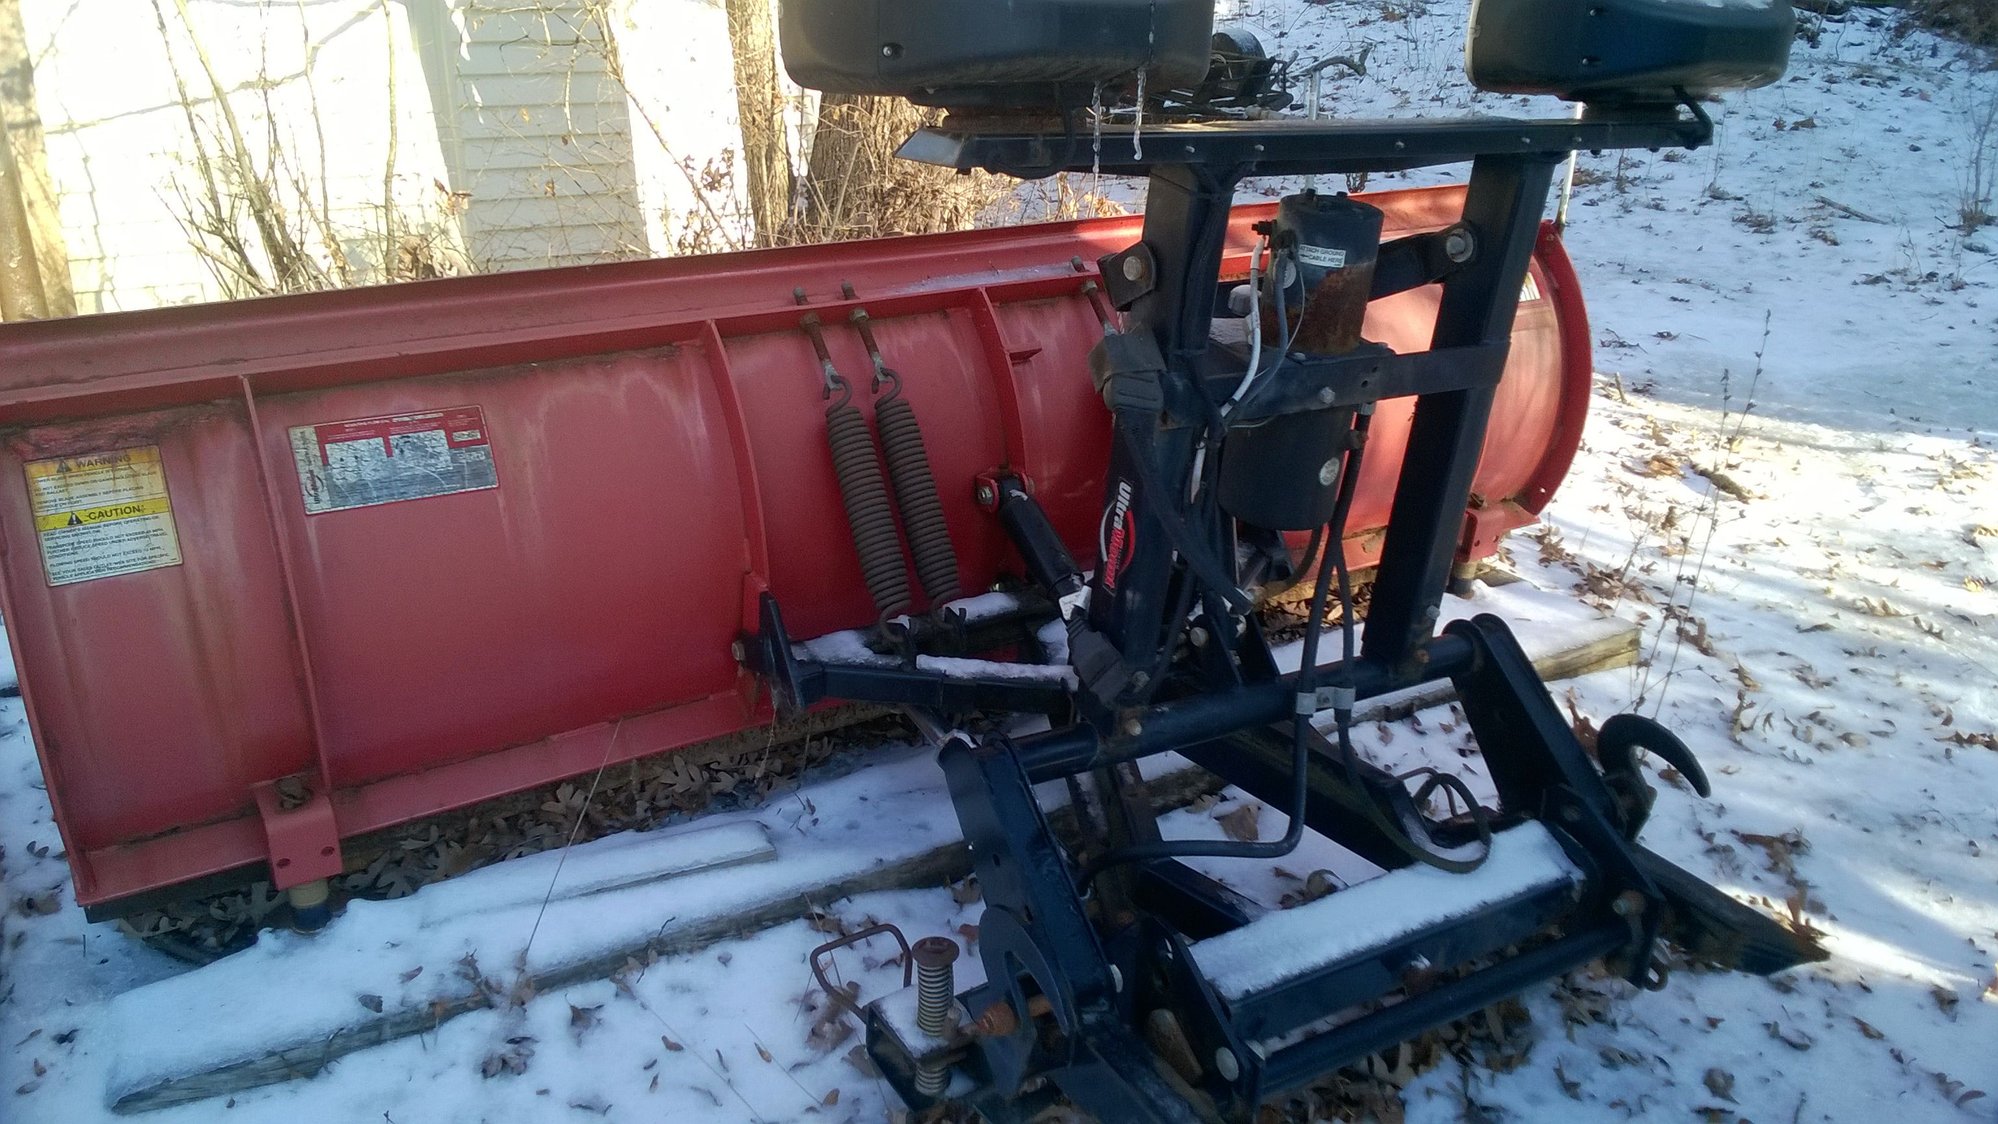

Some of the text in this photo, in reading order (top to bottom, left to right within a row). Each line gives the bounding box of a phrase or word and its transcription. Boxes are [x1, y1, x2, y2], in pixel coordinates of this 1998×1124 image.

[1300, 245, 1344, 257] ATTACH GROUND
[1308, 254, 1327, 262] CABLE
[76, 454, 131, 468] WARNING
[88, 505, 141, 520] CAUTION
[1104, 481, 1131, 589] UltraMount
